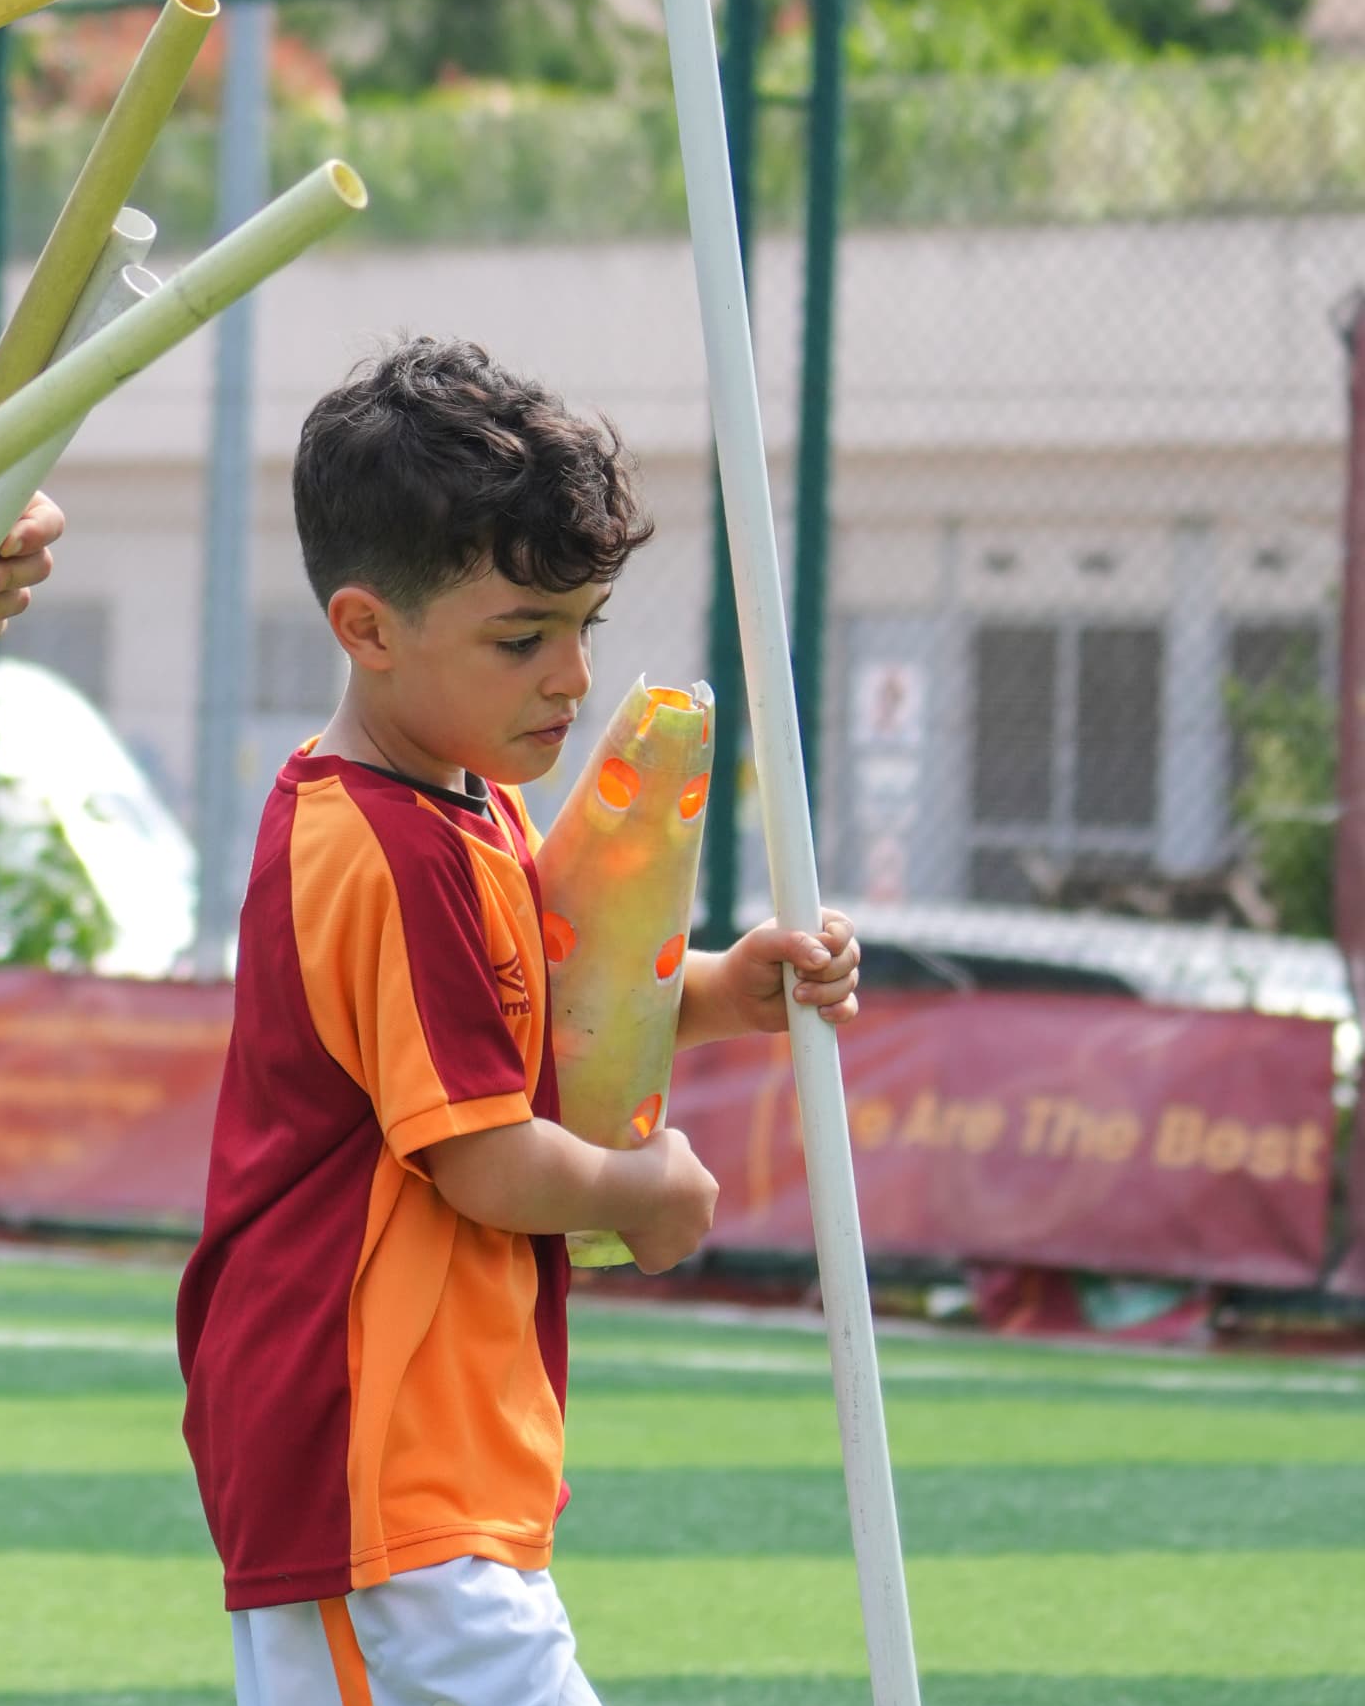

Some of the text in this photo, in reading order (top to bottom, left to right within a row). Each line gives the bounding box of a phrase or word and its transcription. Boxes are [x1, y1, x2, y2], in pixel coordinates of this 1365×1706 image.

[903, 1087, 1008, 1155] Are
[1019, 1094, 1140, 1164] The
[1155, 1102, 1327, 1185] Best
